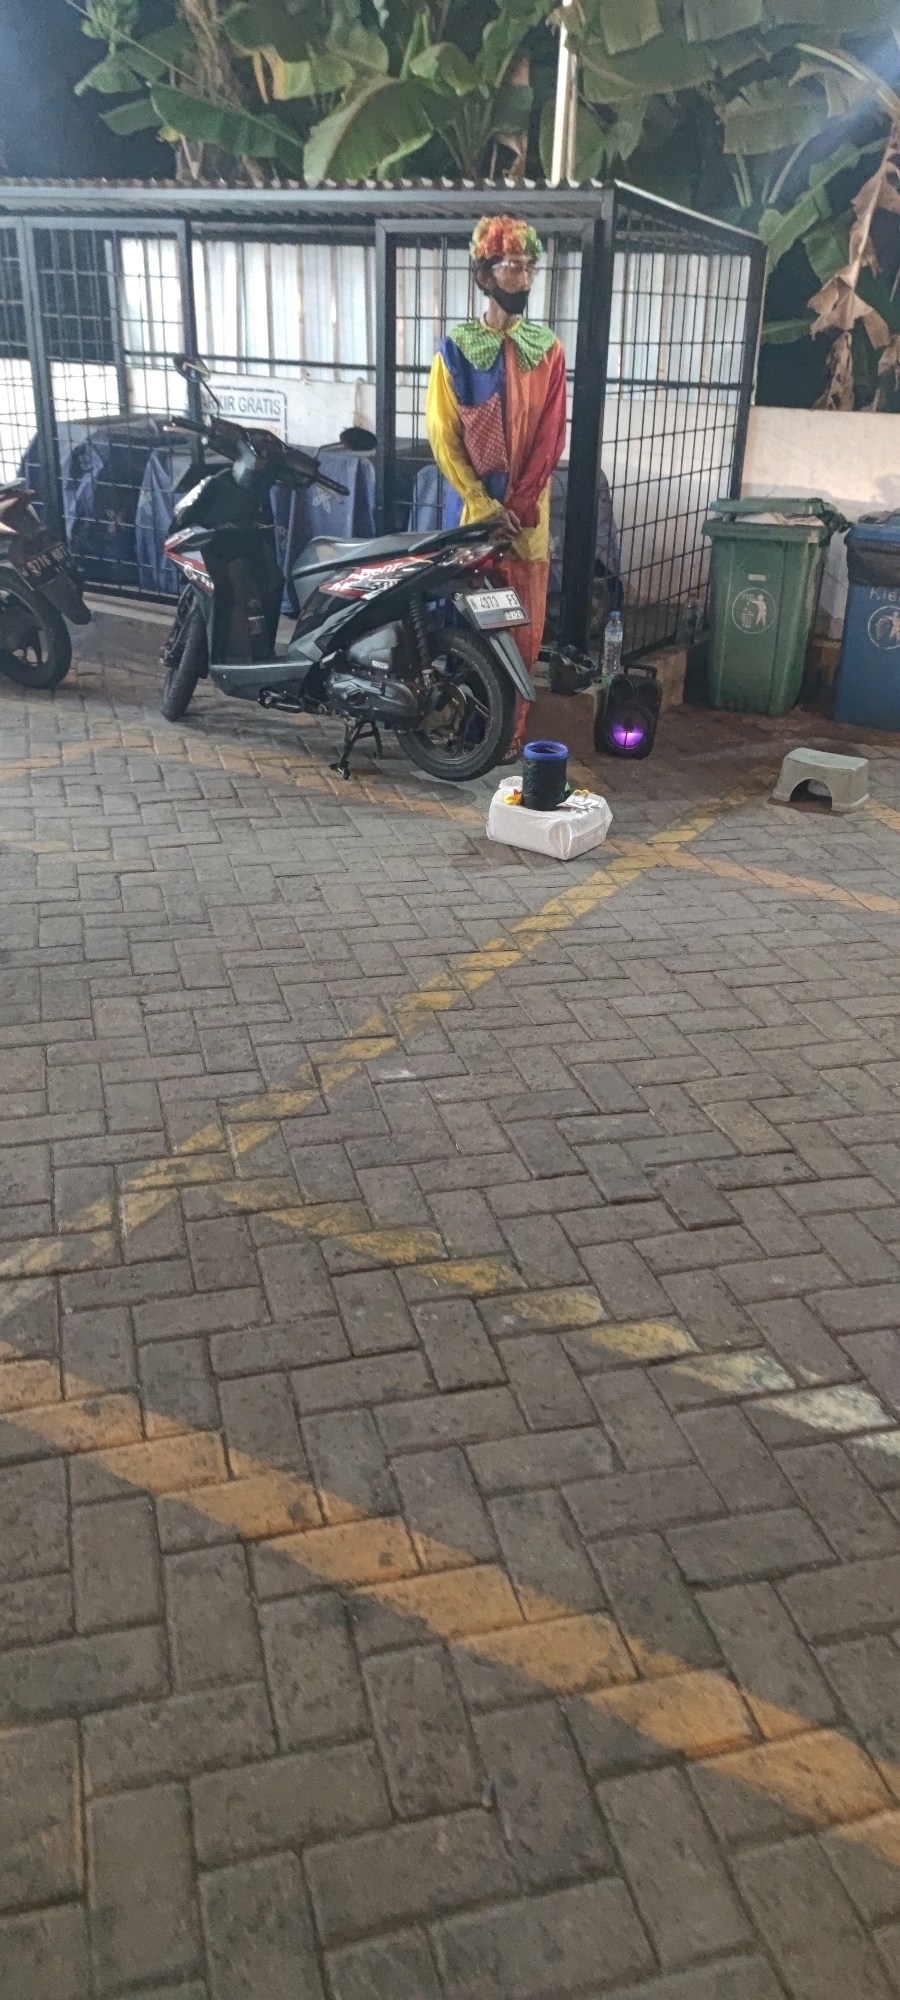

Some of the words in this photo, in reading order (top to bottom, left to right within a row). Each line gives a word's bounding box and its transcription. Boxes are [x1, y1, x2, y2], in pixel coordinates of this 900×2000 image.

[238, 396, 281, 415] GRATIS
[480, 595, 499, 609] 4373
[506, 593, 519, 606] FS
